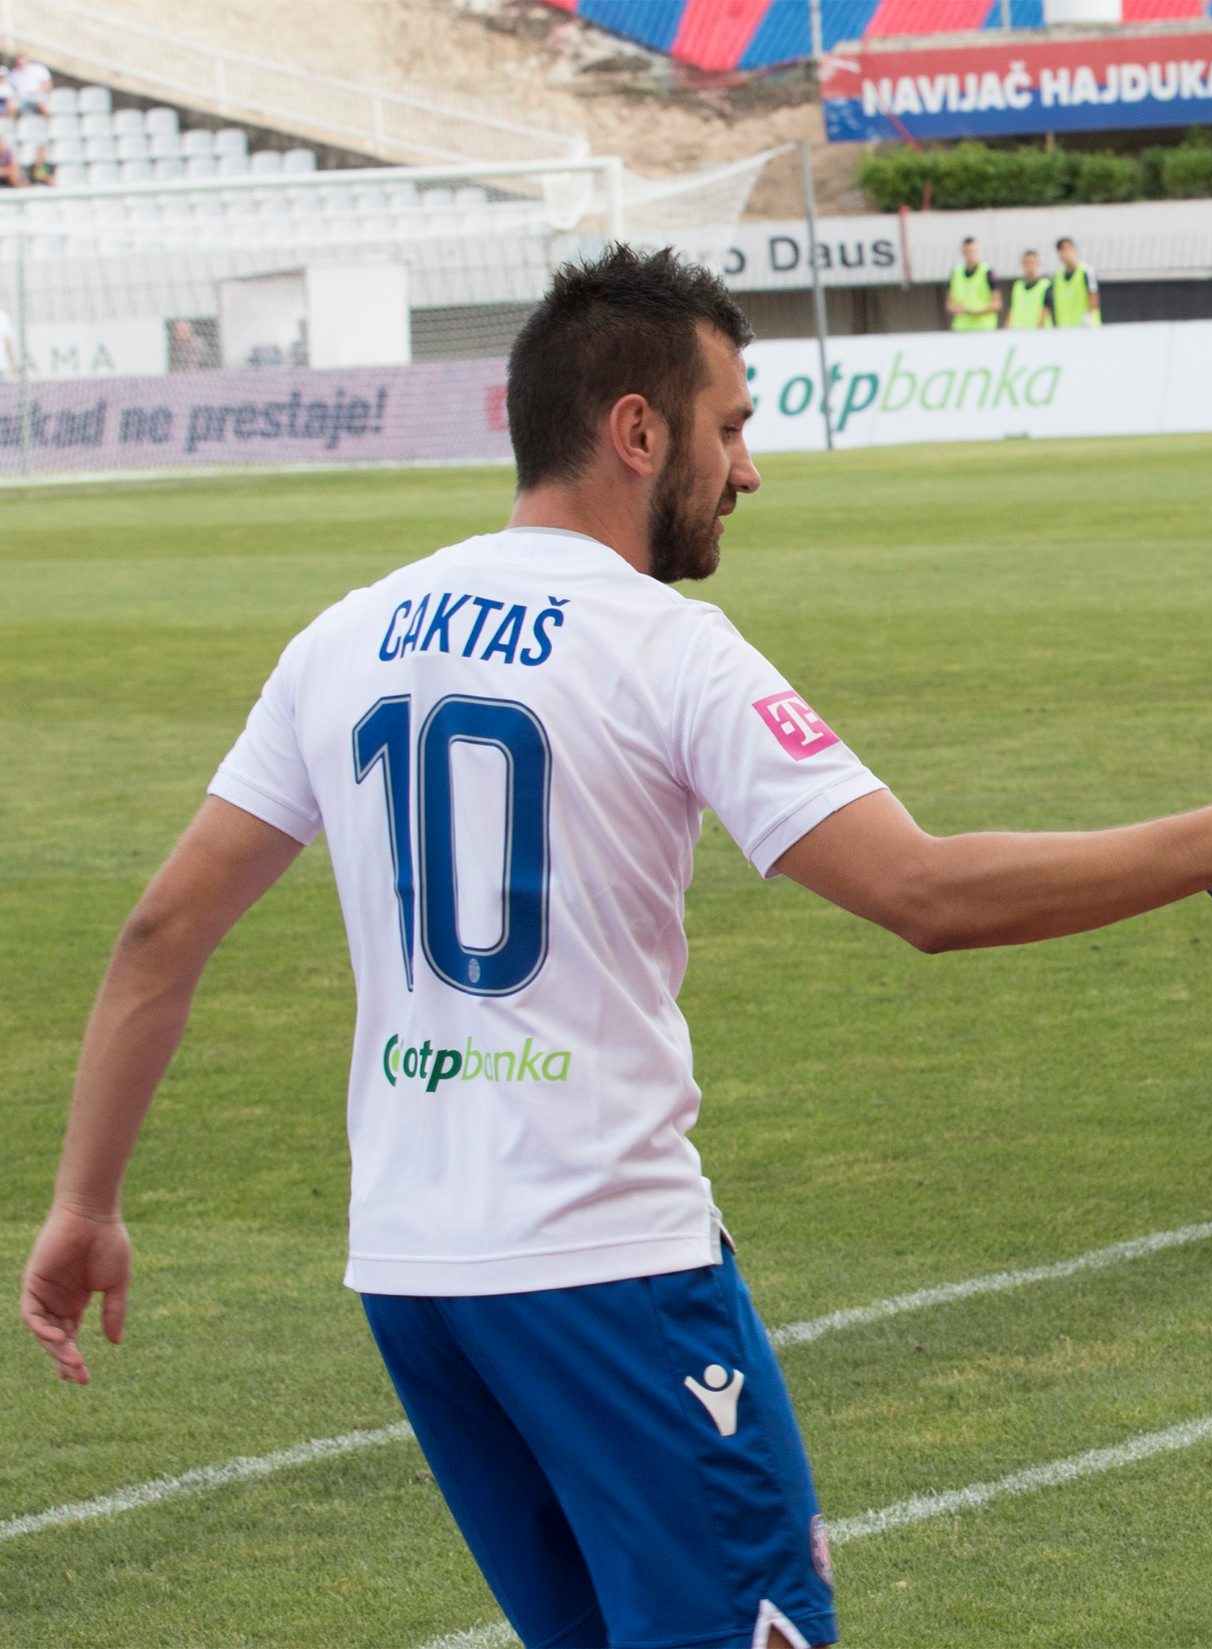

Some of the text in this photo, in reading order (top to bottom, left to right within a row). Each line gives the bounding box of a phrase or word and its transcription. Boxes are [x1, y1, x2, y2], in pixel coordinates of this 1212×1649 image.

[861, 59, 1032, 117] NAVIJAČ
[769, 235, 896, 272] Daus
[118, 405, 174, 446] ne
[184, 384, 389, 454] prestaje!
[378, 592, 571, 668] CAKTAŠ
[352, 693, 553, 999] 10
